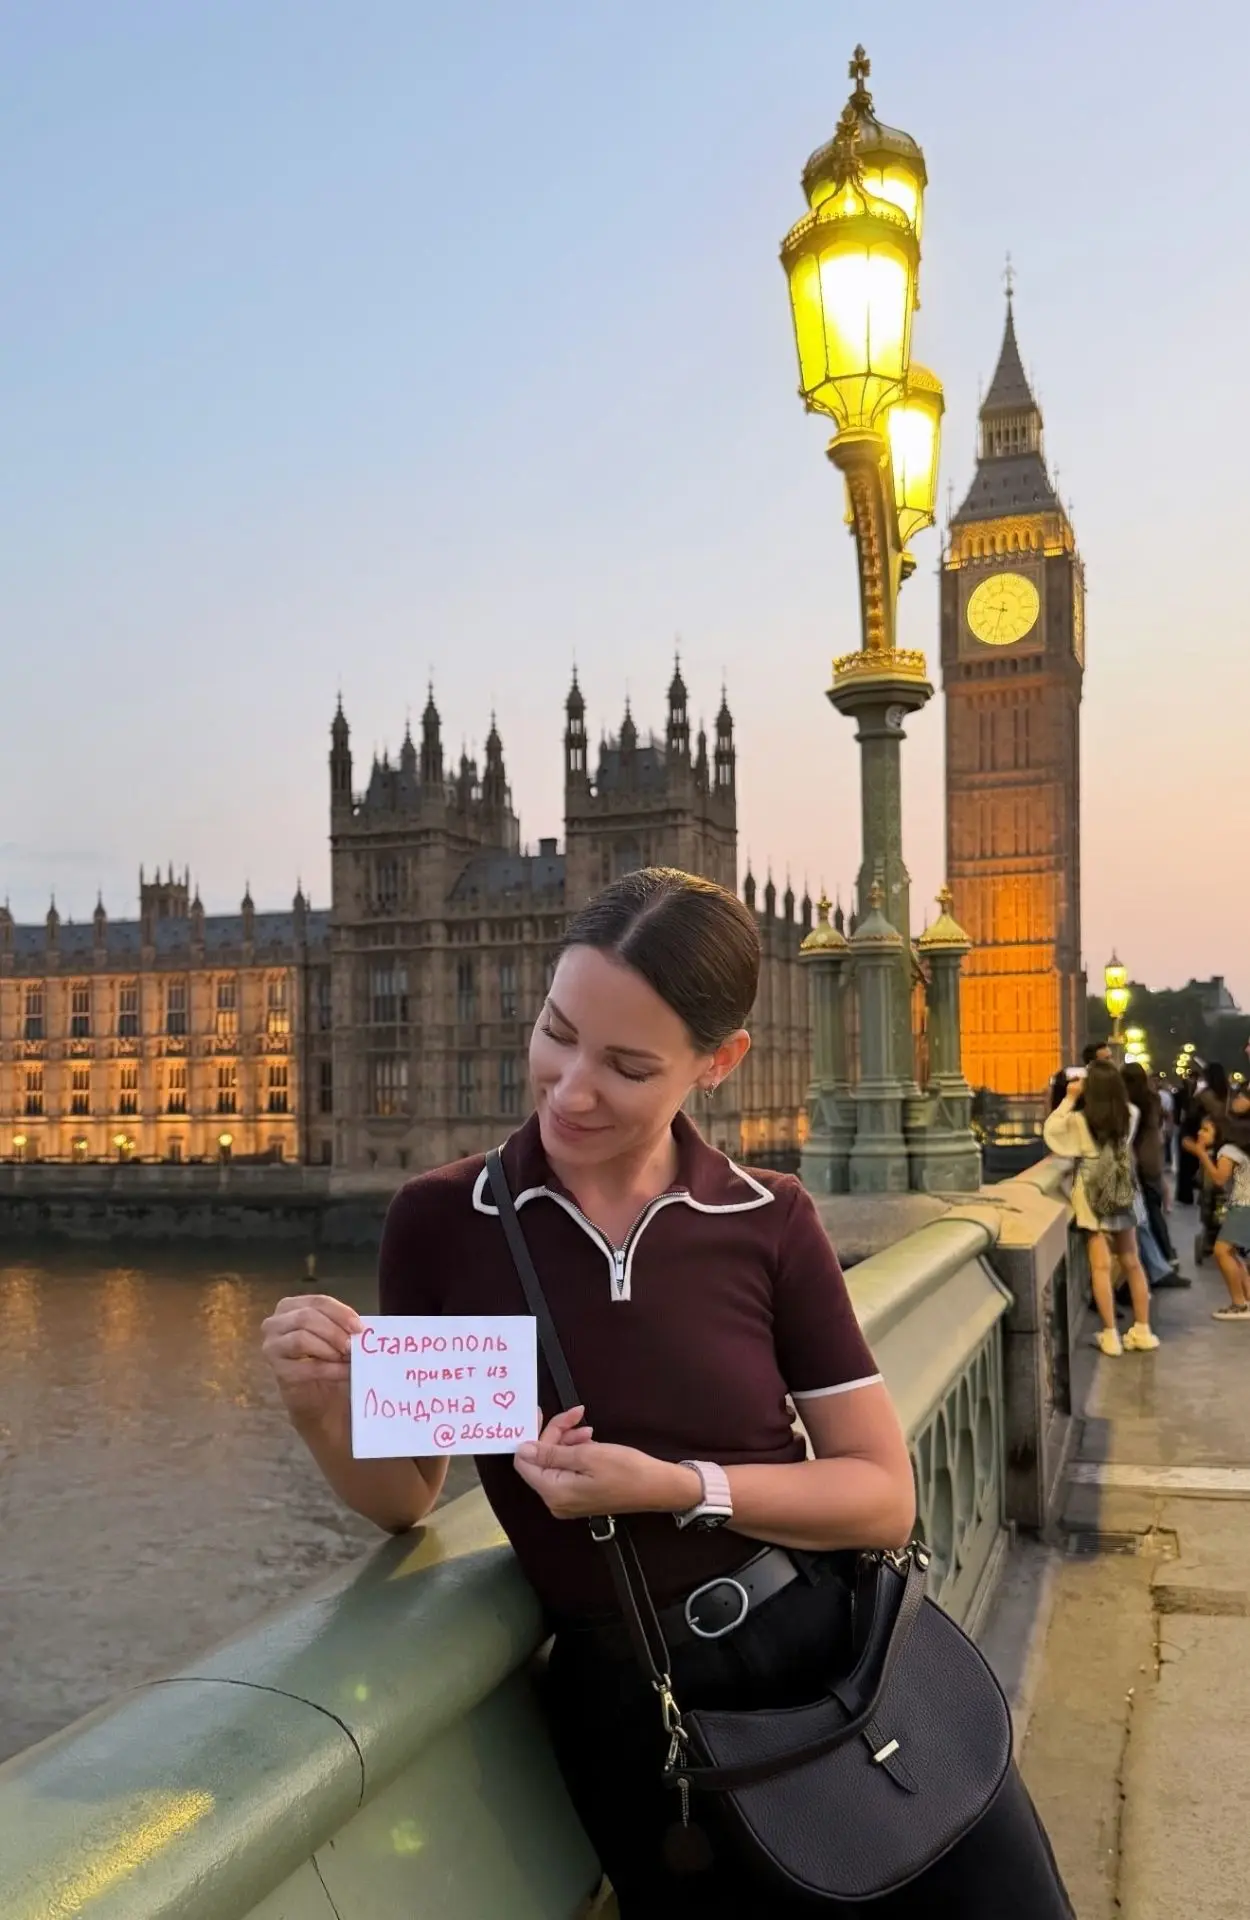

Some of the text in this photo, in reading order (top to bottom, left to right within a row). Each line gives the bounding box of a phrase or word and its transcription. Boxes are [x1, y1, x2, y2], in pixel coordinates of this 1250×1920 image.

[361, 1327, 508, 1354] Ставрополь
[405, 1365, 508, 1387] привет из
[364, 1388, 475, 1421] Лондона
[433, 1422, 525, 1448] @26stav
